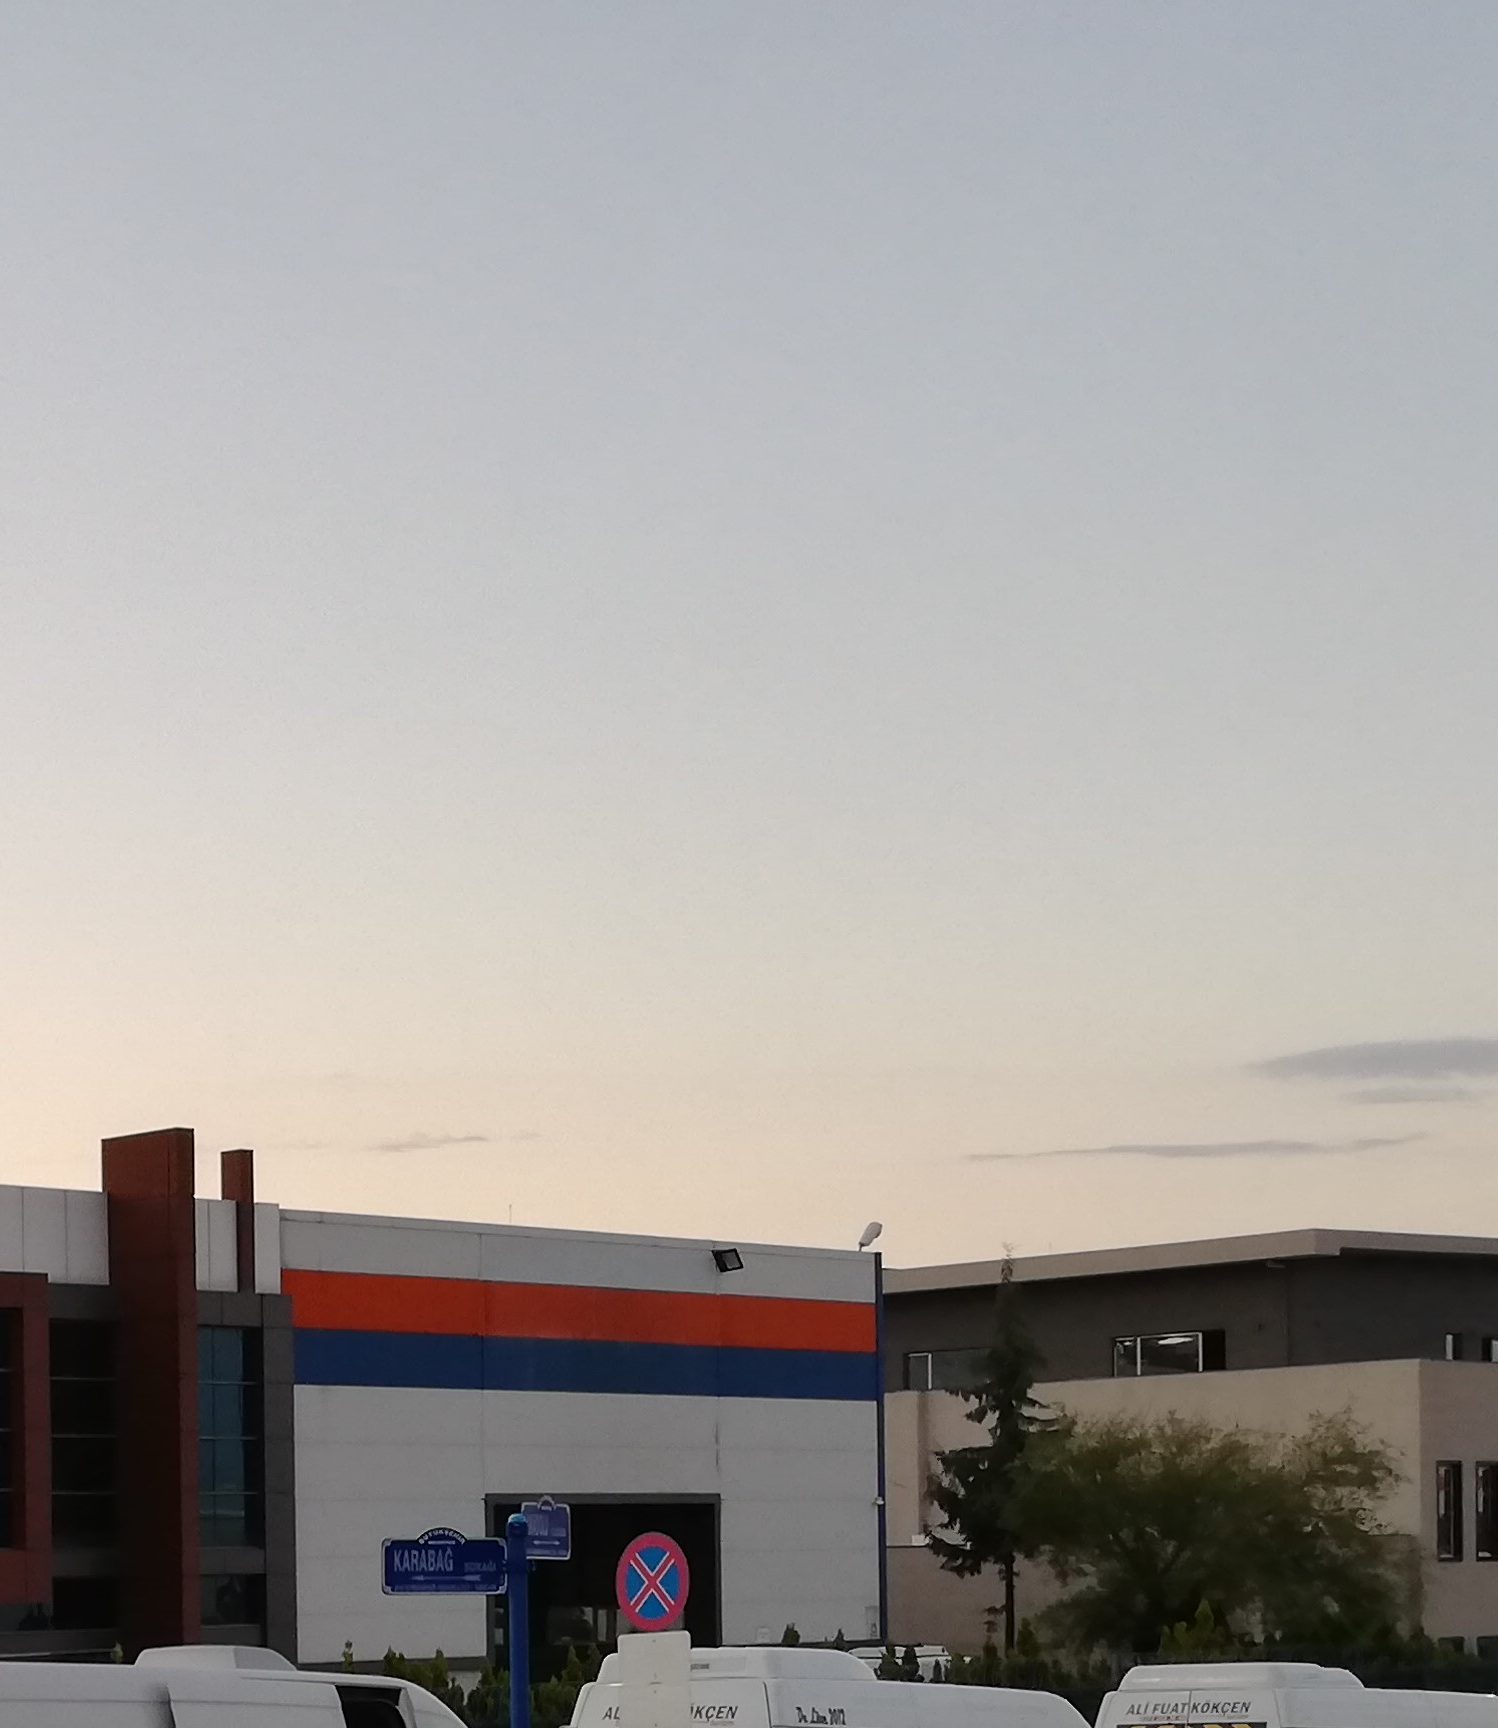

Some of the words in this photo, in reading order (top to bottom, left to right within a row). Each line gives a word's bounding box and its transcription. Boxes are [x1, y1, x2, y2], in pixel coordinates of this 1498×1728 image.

[603, 1707, 620, 1720] AL
[1126, 1701, 1149, 1715] ALİ
[1153, 1702, 1188, 1715] FUAT
[1191, 1700, 1251, 1717] KÖKÇEN
